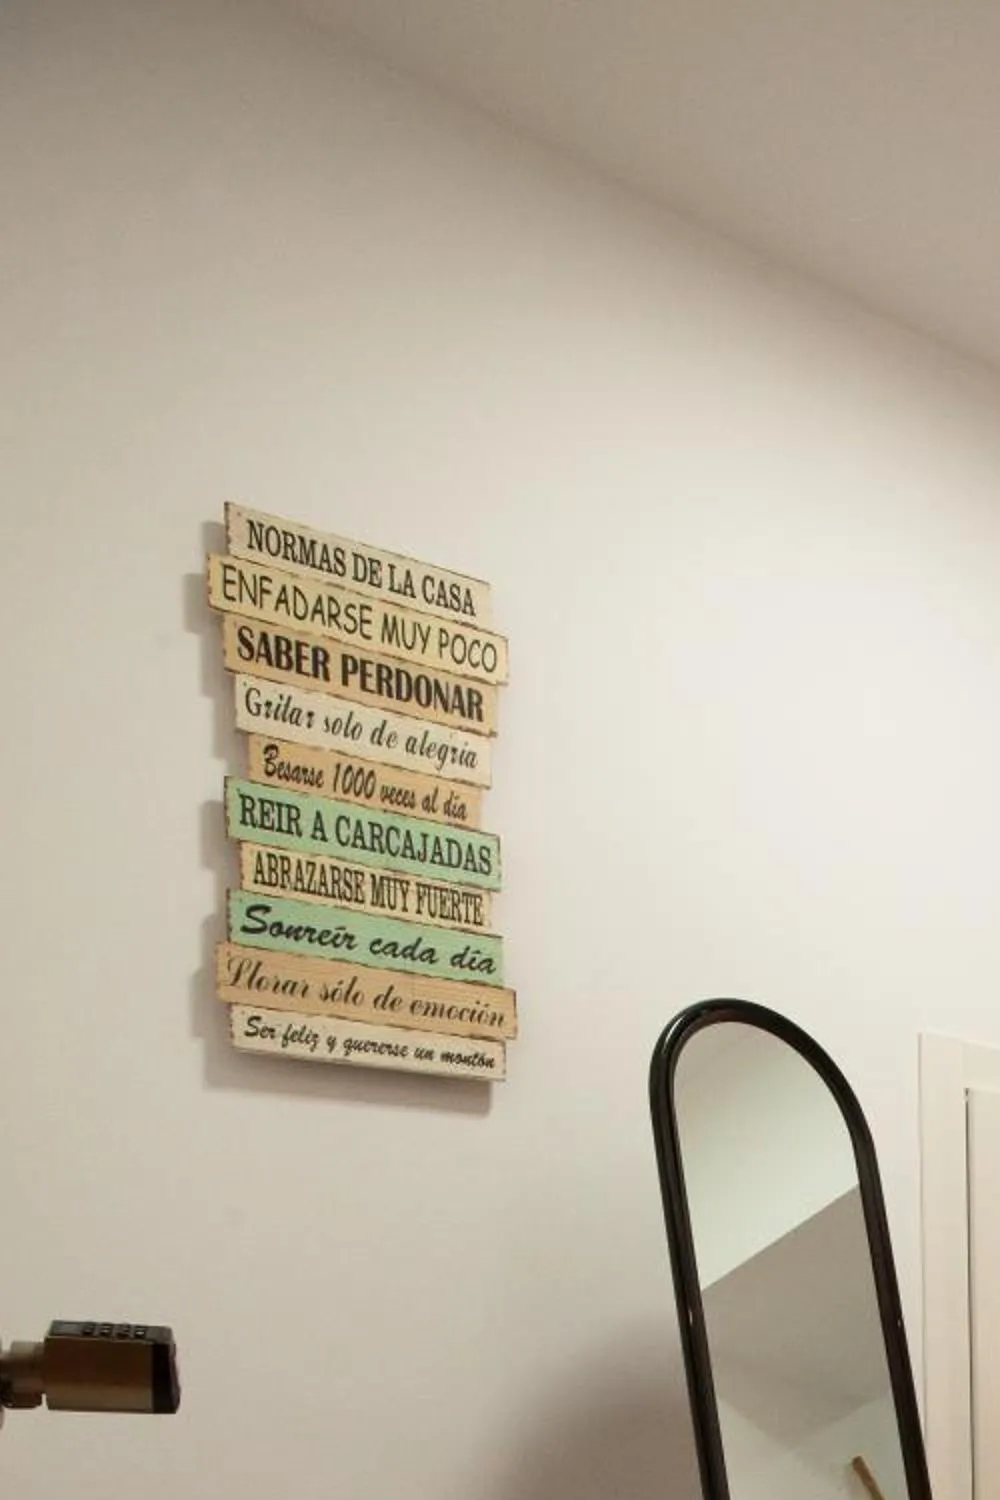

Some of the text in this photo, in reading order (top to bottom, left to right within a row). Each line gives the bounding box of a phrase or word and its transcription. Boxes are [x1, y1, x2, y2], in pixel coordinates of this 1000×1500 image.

[246, 519, 477, 617] NORMAS DE LA CASA
[222, 564, 497, 673] ENFADARSE MUY POCO
[237, 626, 484, 722] SABER PERDONAR
[324, 710, 363, 741] solo
[370, 719, 398, 749] de
[263, 744, 324, 789] Besarse
[333, 762, 377, 799] 1000
[381, 783, 416, 810] veces
[422, 785, 438, 814] al
[238, 793, 493, 876] REIR A CARCAJADAS
[253, 851, 483, 926] ABRAZARSE MUY FUERTE
[369, 937, 439, 965] cada
[373, 984, 402, 1011] de
[244, 1016, 276, 1039] Ser
[281, 1024, 318, 1053] feliz
[326, 1035, 337, 1053] y
[342, 1037, 408, 1057] quererse
[414, 1047, 434, 1061] un
